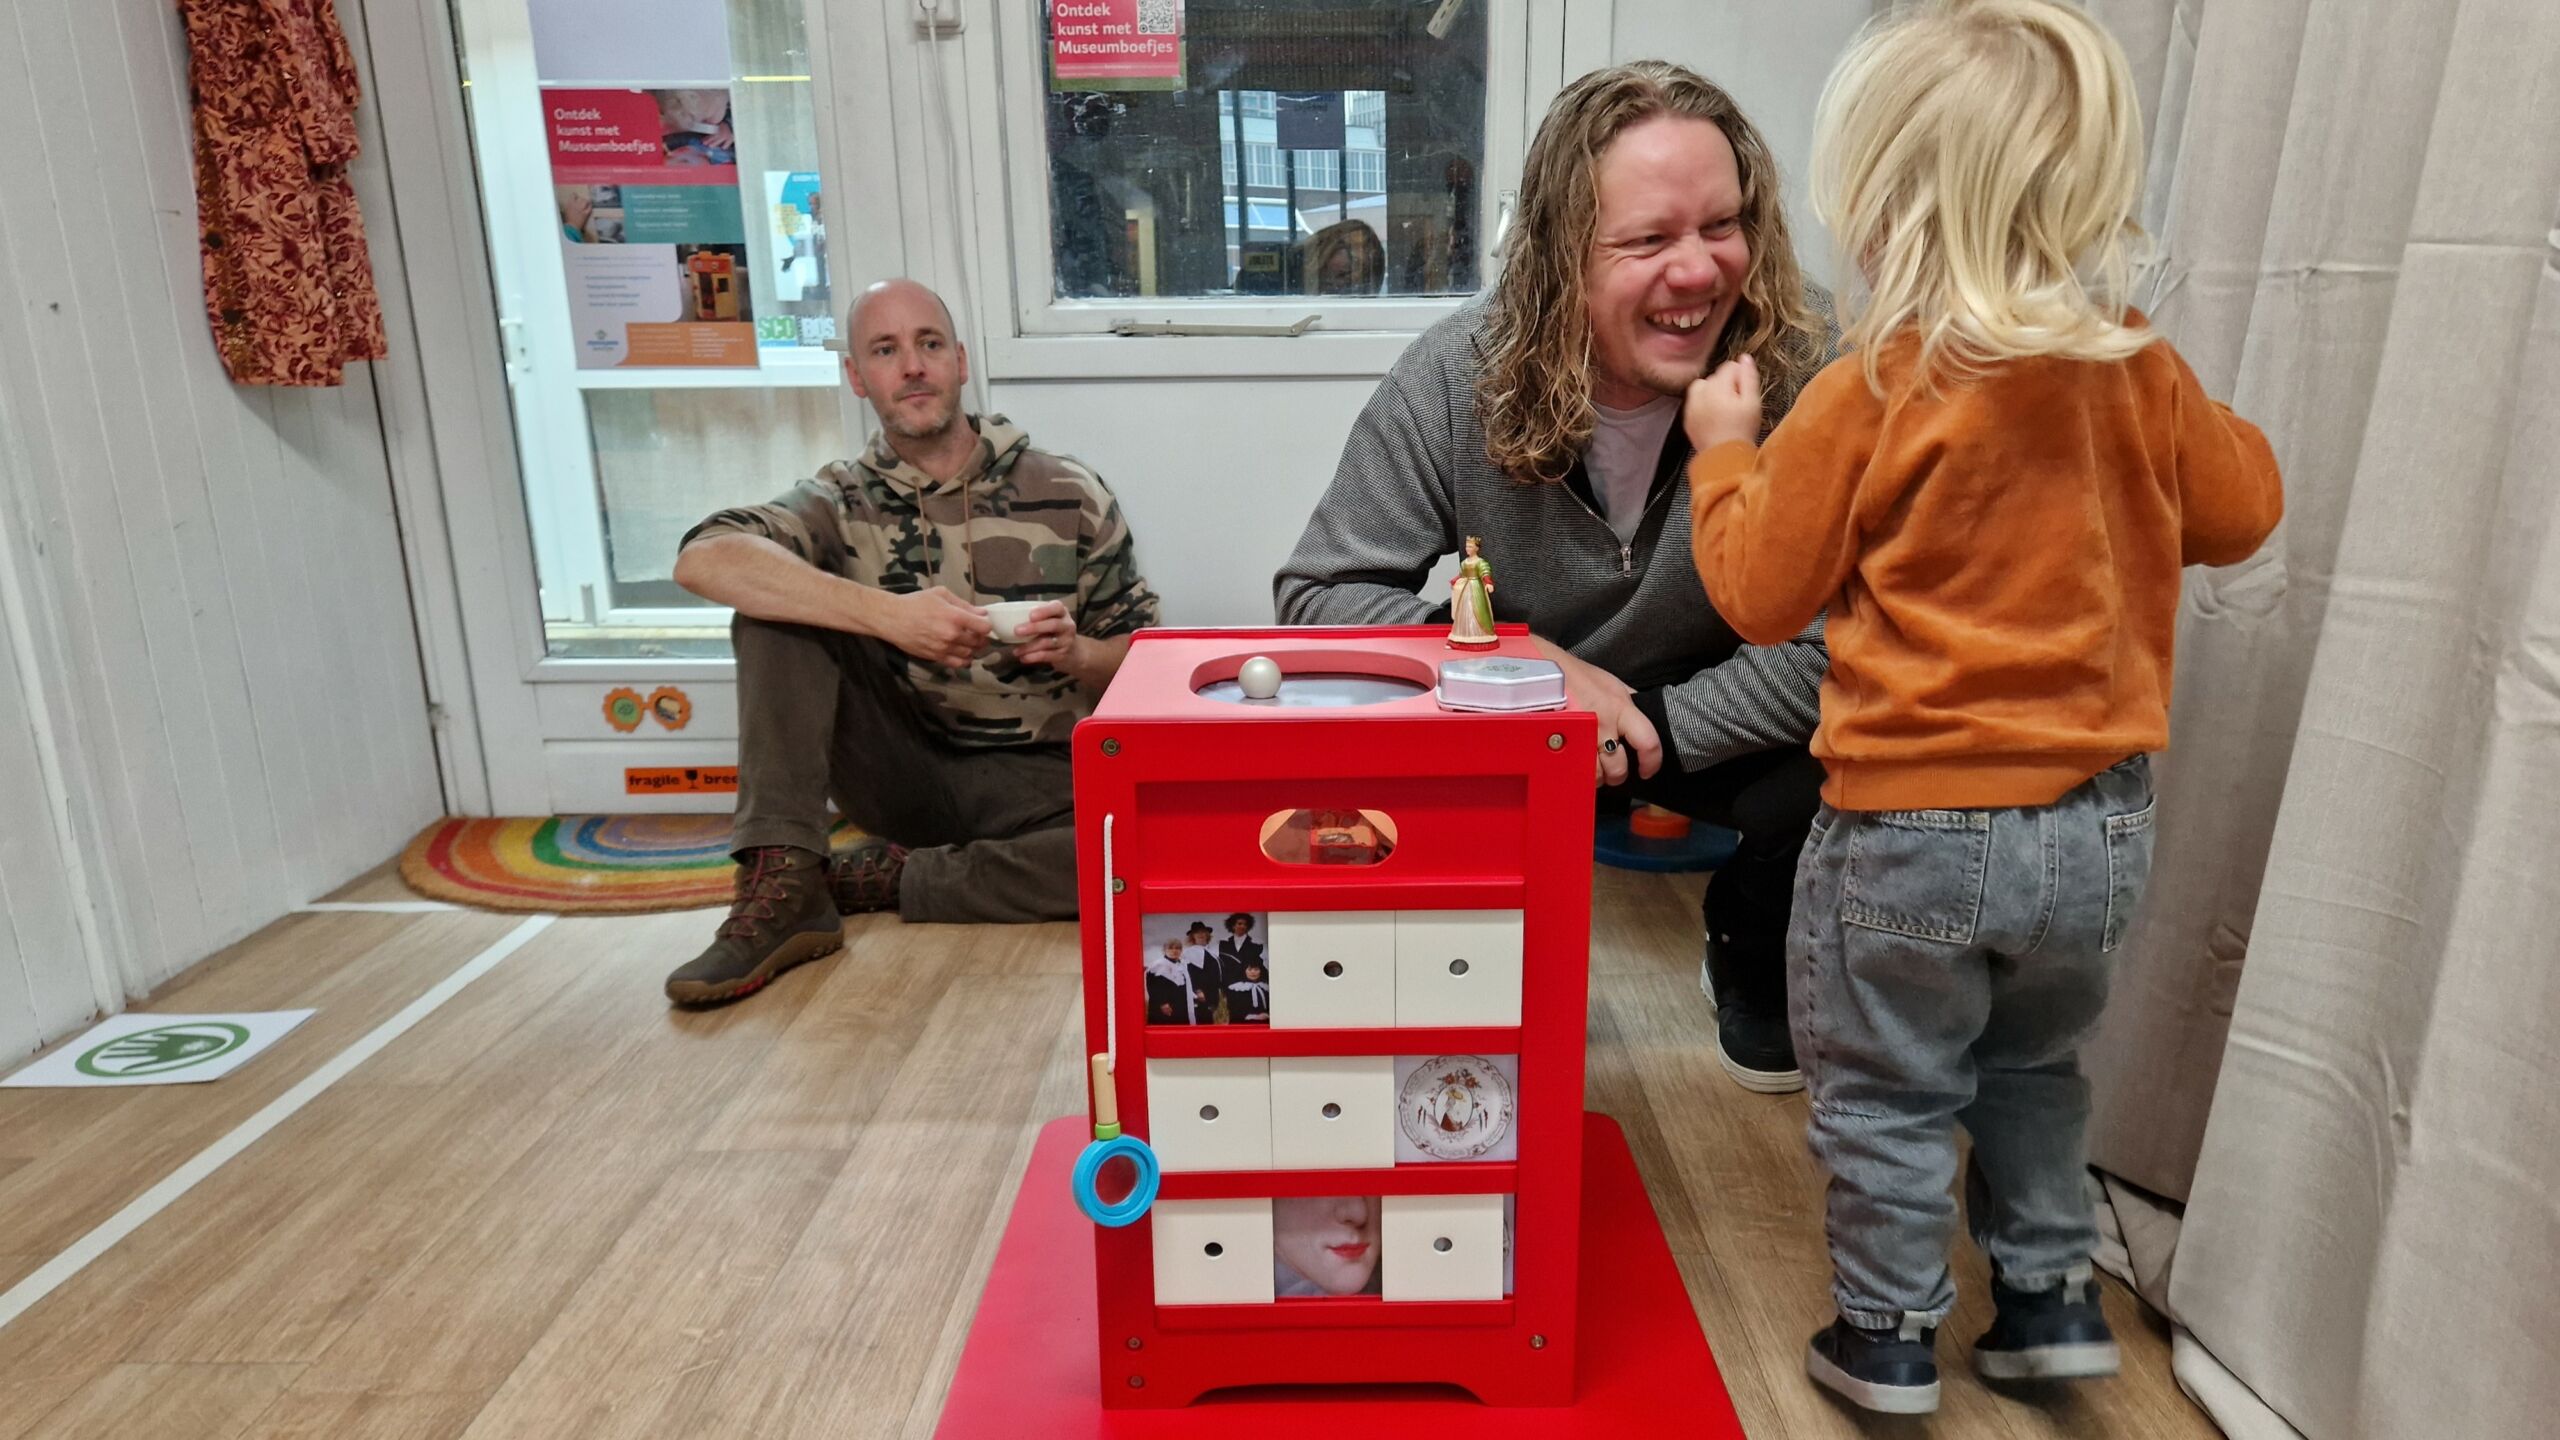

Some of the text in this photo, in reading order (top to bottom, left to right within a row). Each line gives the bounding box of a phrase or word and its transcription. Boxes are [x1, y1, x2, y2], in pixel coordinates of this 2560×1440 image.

[1056, 3, 1111, 17] Ontdek
[1057, 22, 1131, 36] kunst met
[1059, 39, 1173, 57] Museumboefjes
[554, 108, 601, 120] Ontdek
[556, 124, 620, 136] kunst met
[559, 139, 656, 155] Museumboefjes
[628, 775, 680, 788] fragile
